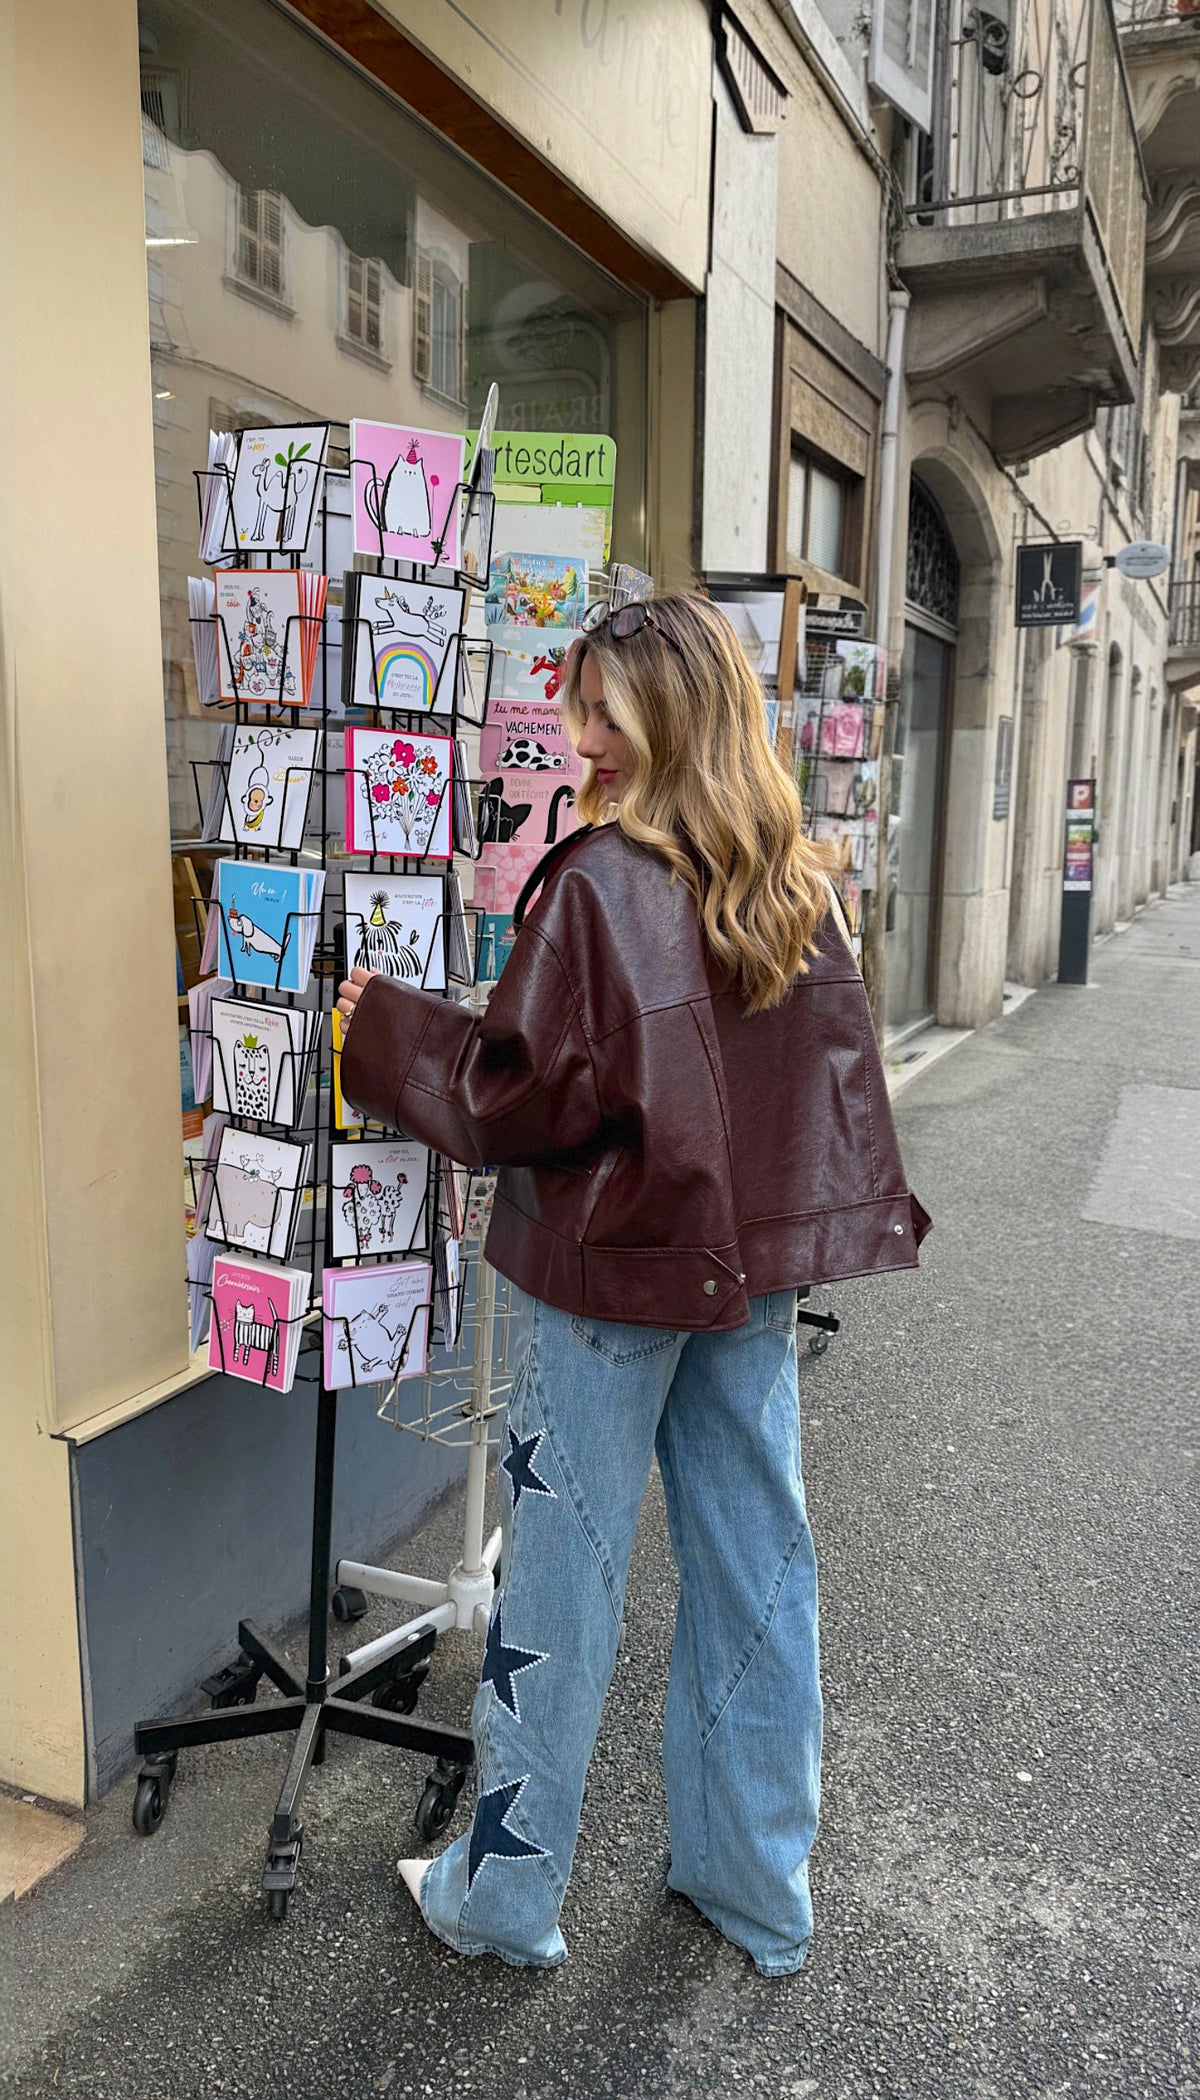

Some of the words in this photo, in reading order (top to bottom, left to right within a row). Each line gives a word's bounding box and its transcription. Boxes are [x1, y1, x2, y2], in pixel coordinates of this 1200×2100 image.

[463, 437, 606, 478] rtesdart
[494, 702, 508, 714] tu
[510, 706, 529, 715] me
[505, 721, 563, 736] VACHEMENT
